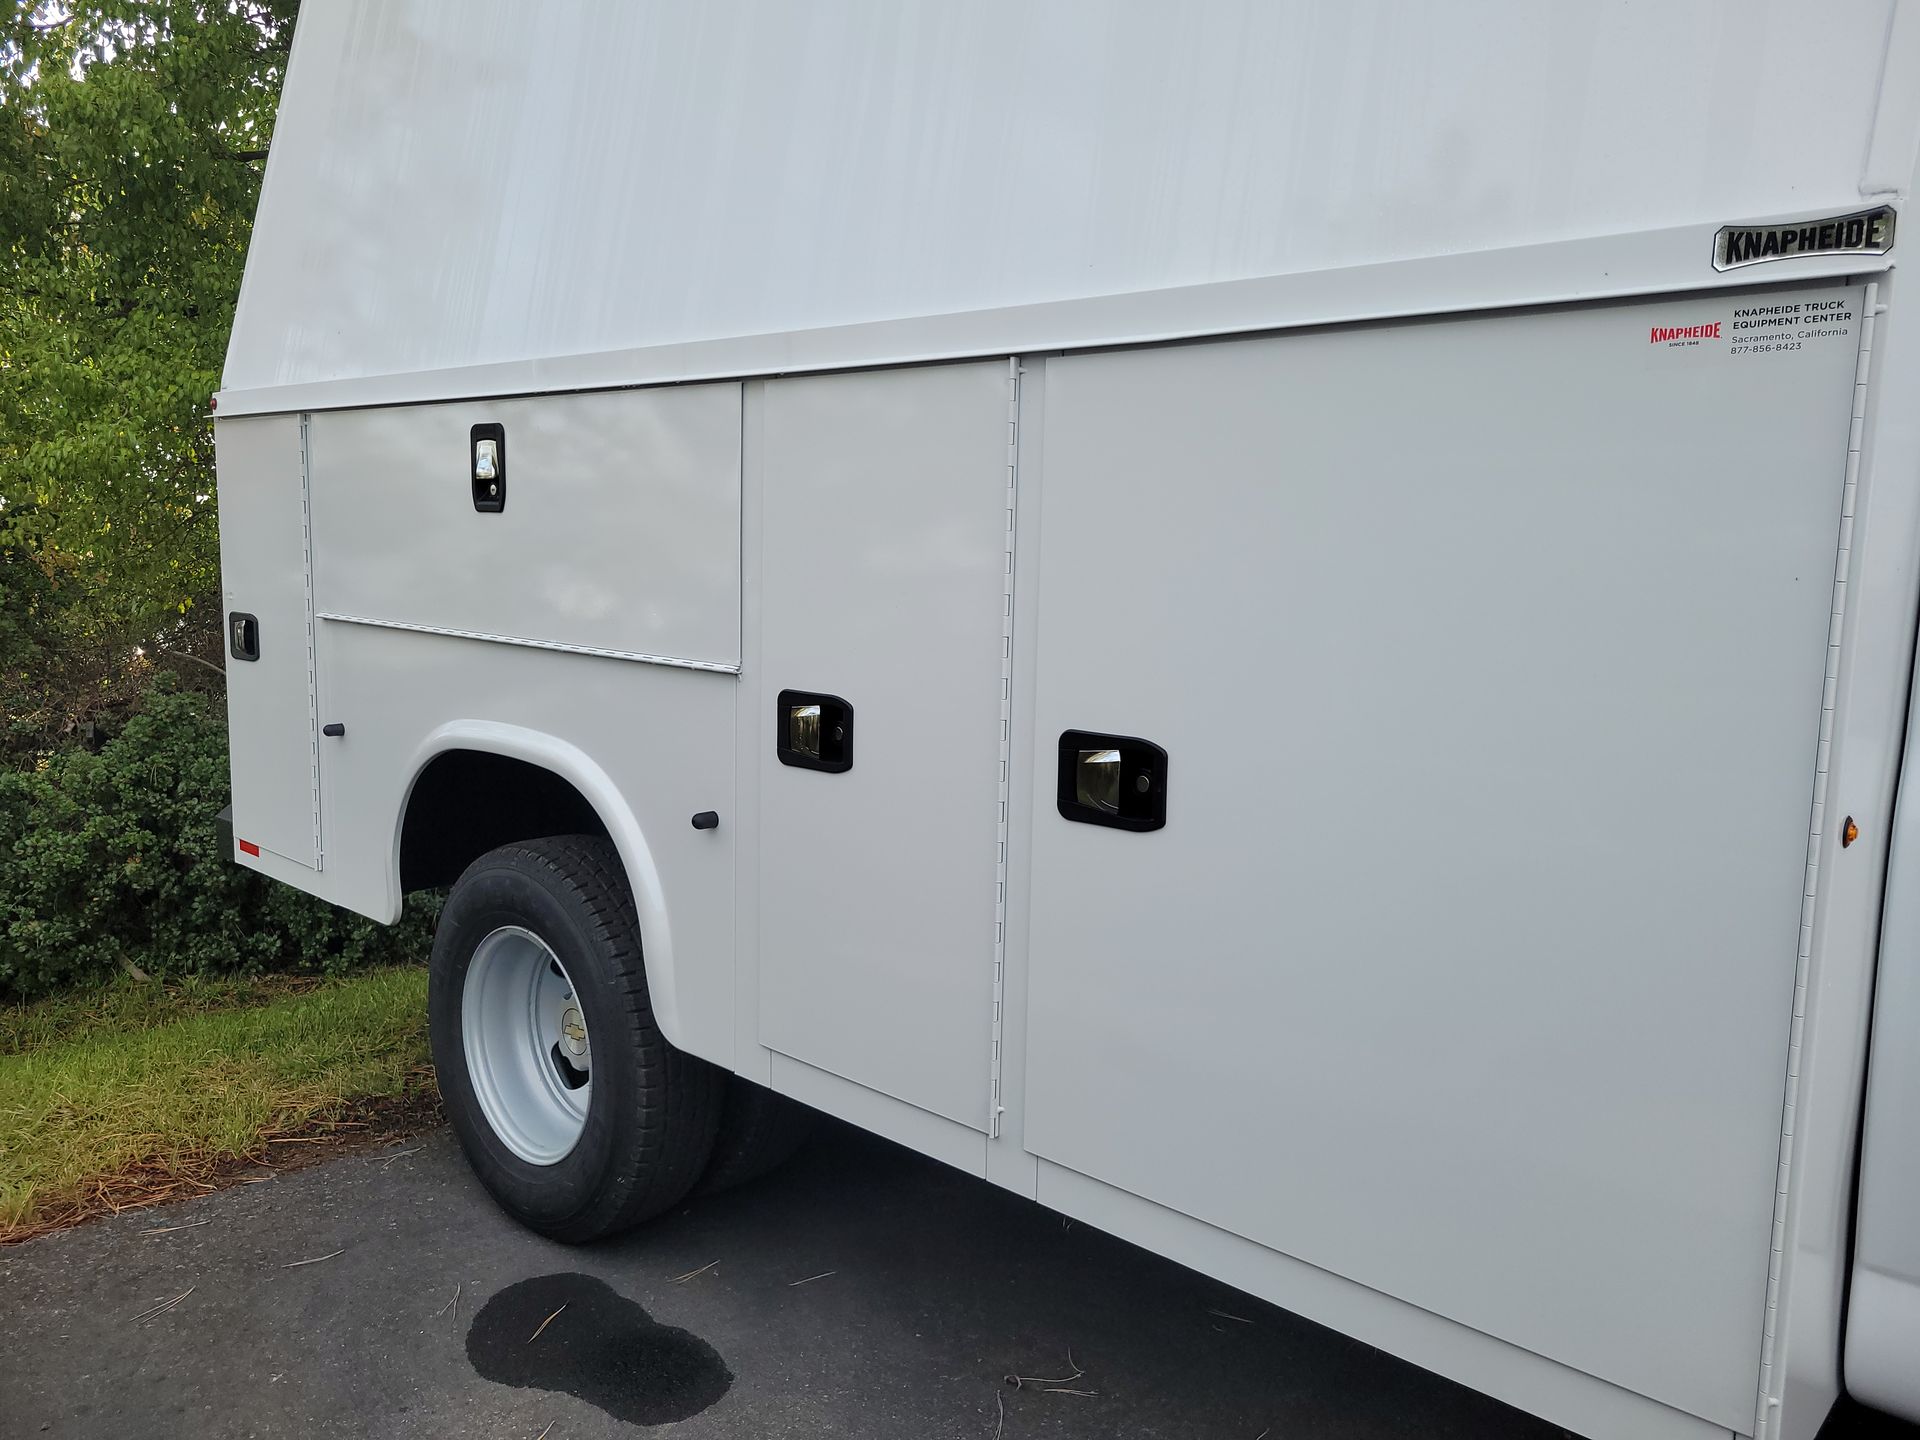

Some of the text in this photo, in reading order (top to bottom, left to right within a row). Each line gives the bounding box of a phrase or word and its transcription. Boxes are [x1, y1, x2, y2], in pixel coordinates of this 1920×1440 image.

[1726, 212, 1886, 265] KNAPHEIDE
[1734, 300, 1846, 318] KNAPHEIDE TRUCK
[1733, 312, 1852, 330] EQUIPMENT CENTER
[1650, 321, 1722, 344] KNAPHEIDE
[1731, 327, 1848, 344] Sacramento, California
[1730, 342, 1802, 355] 877-856-8423
